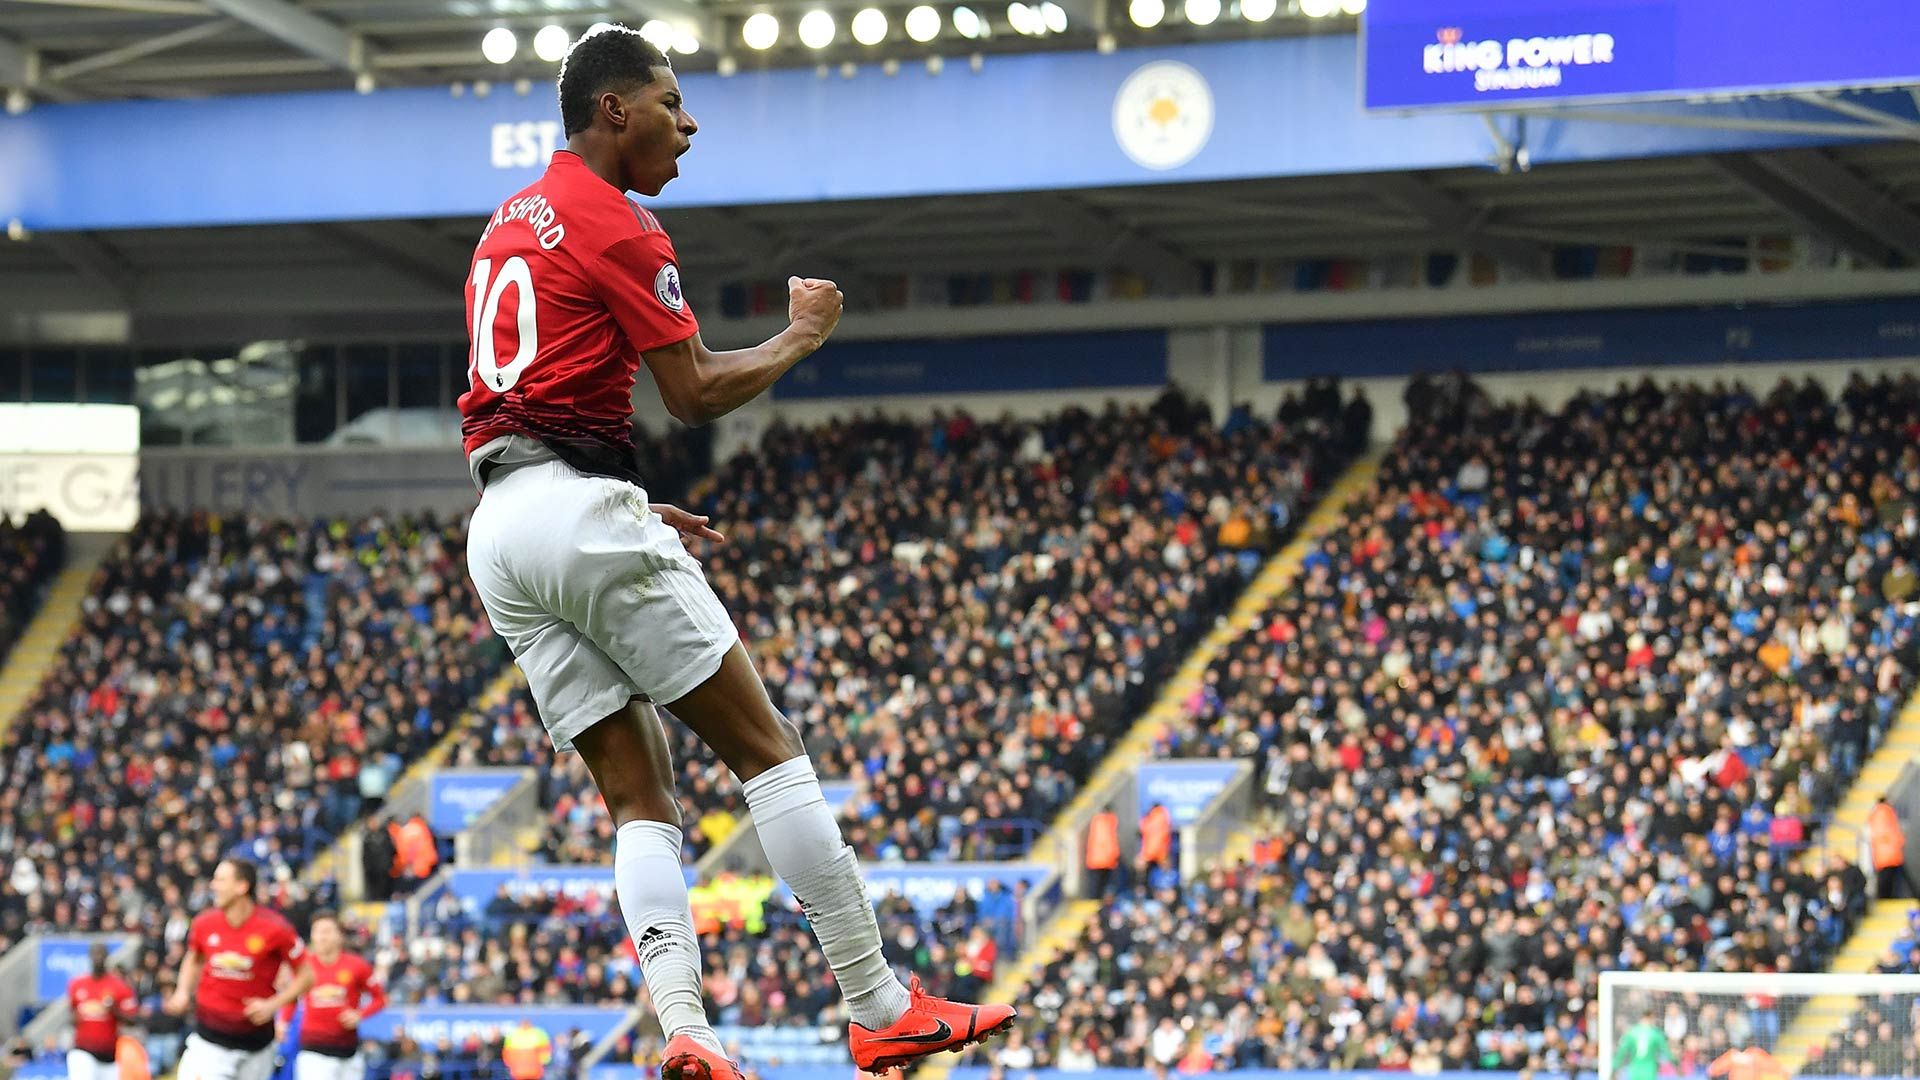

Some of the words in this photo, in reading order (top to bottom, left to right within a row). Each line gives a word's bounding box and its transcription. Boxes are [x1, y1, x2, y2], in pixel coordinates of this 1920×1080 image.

[1423, 40, 1503, 74] KING
[1507, 33, 1614, 68] POWER
[491, 120, 559, 168] EST
[467, 256, 538, 393] 10
